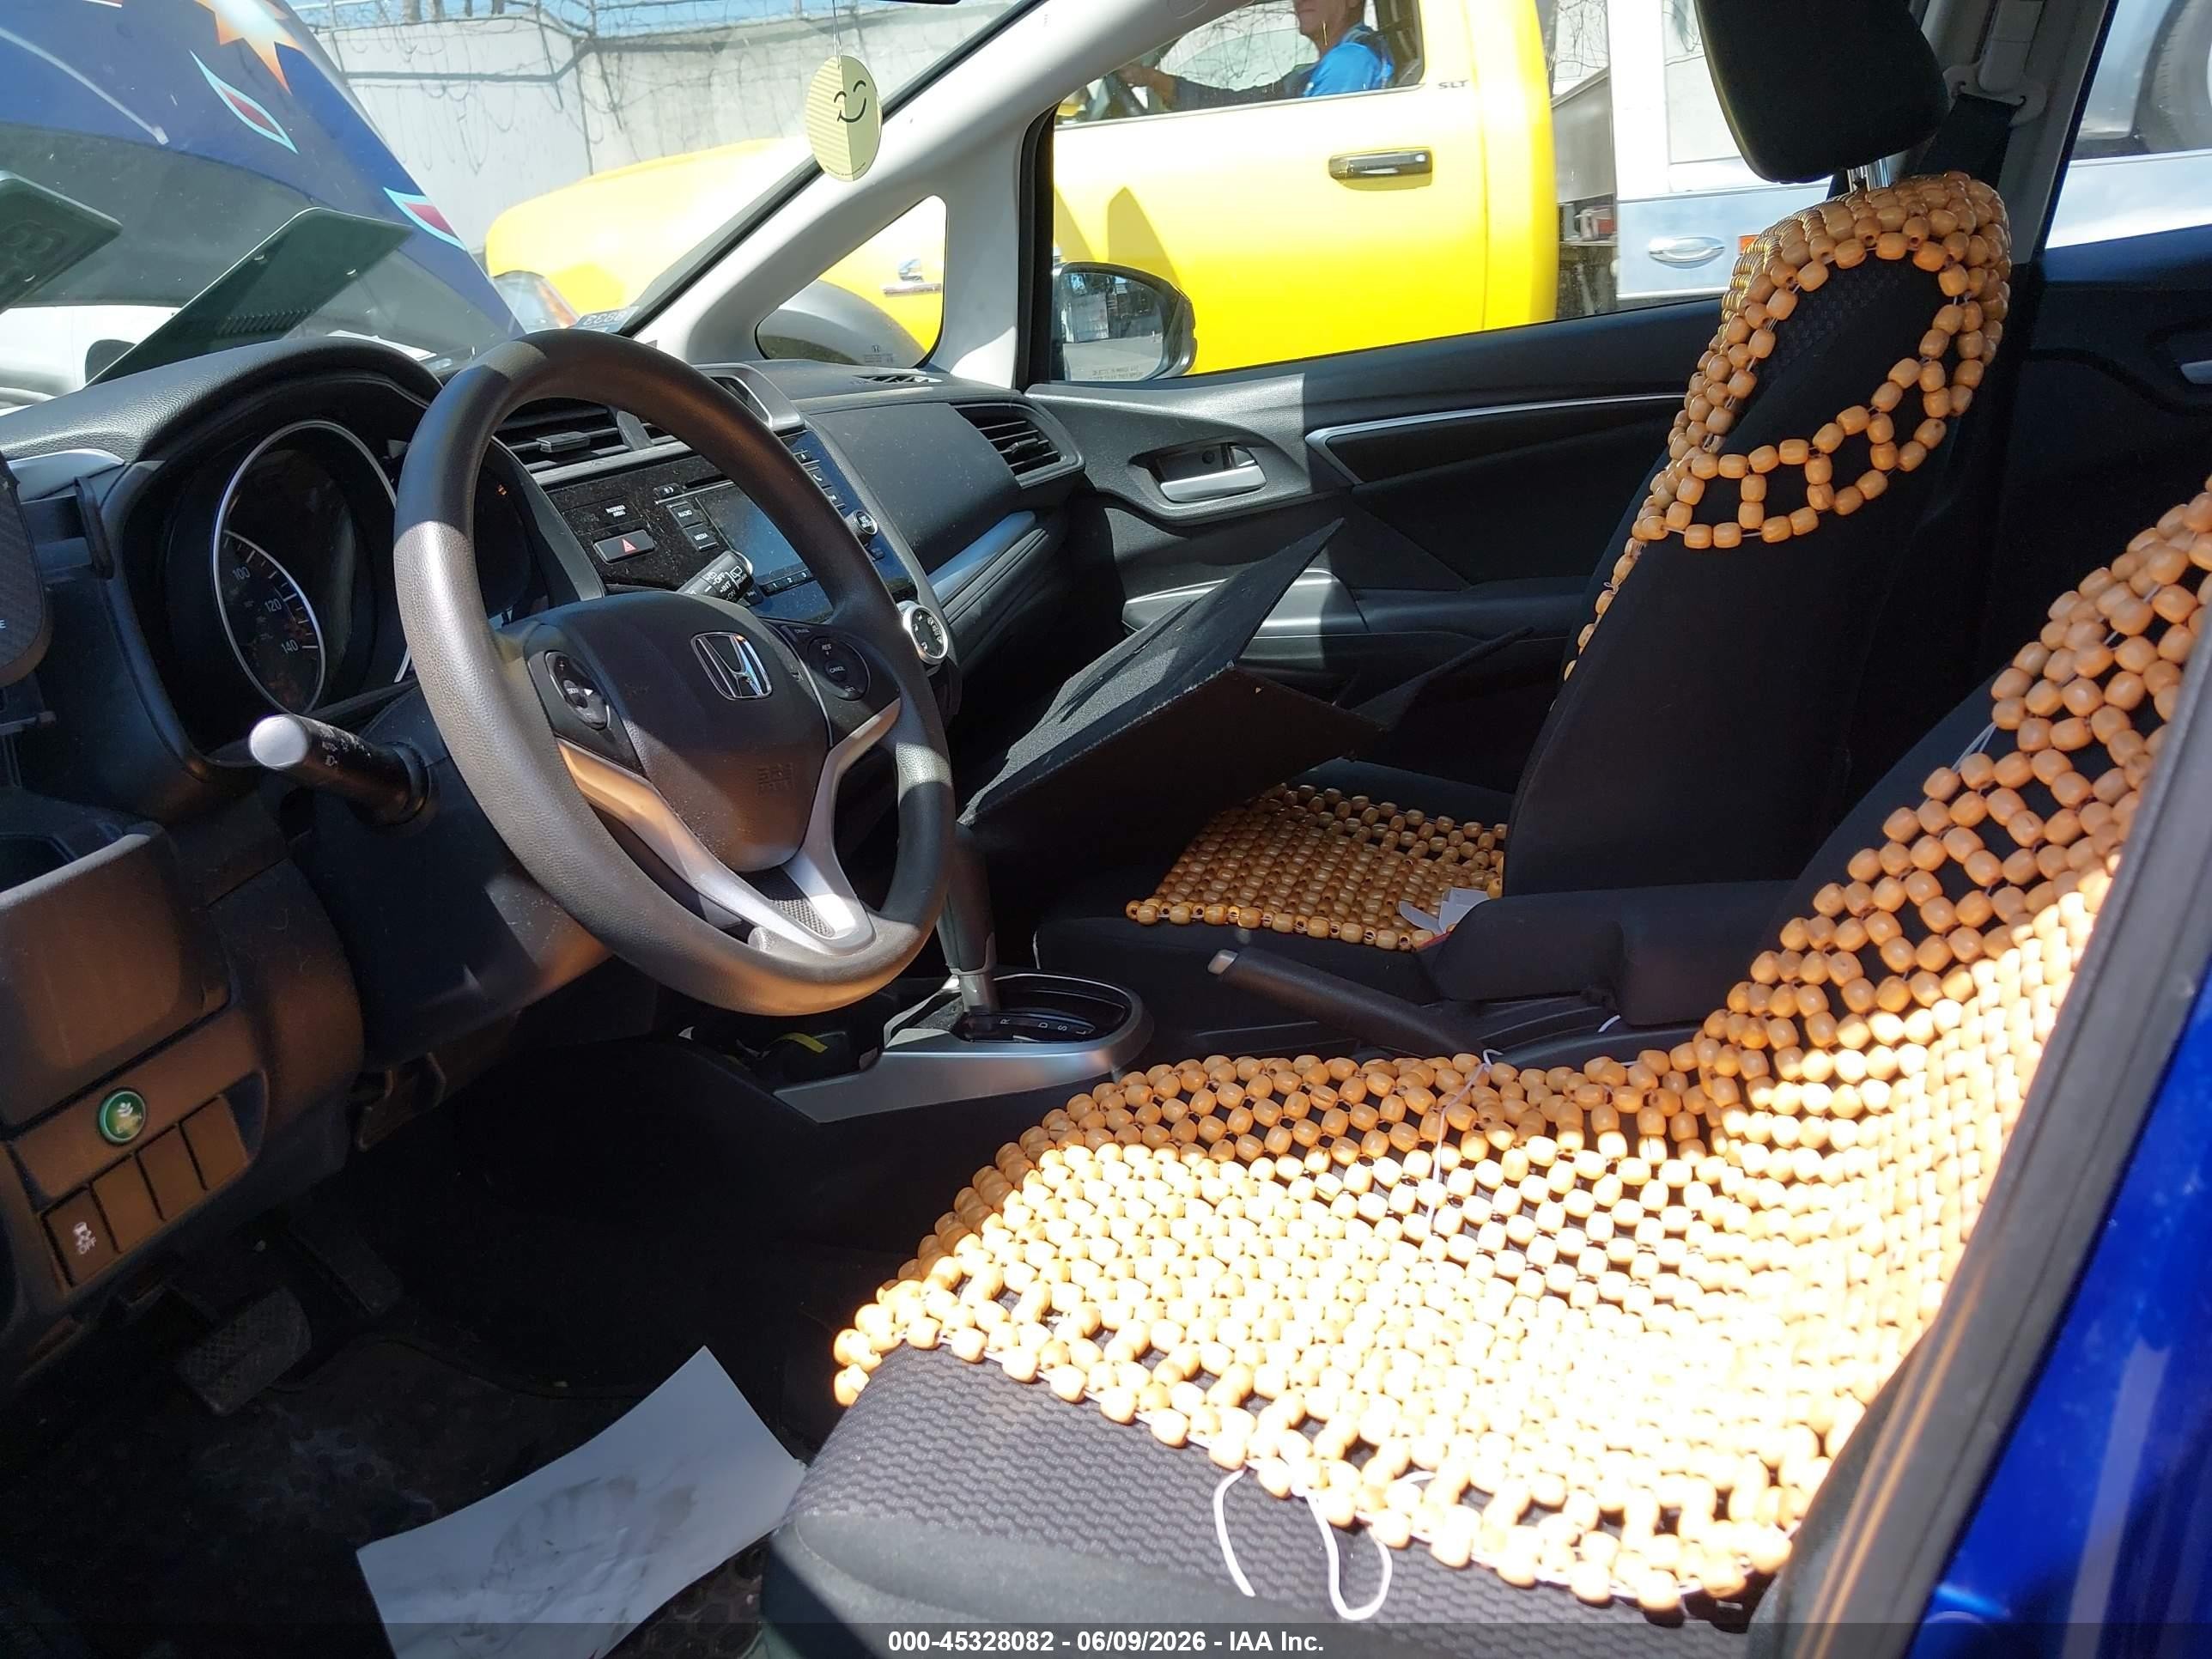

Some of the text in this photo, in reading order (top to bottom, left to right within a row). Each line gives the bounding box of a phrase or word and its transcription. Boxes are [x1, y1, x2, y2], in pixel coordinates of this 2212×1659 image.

[1437, 79, 1469, 89] SLT
[678, 509, 693, 518] RADIO
[232, 567, 251, 581] 100
[714, 571, 726, 584] OFF
[721, 581, 732, 592] INT
[264, 598, 283, 612] 120
[281, 639, 299, 653] 140
[78, 1237, 96, 1254] OFF
